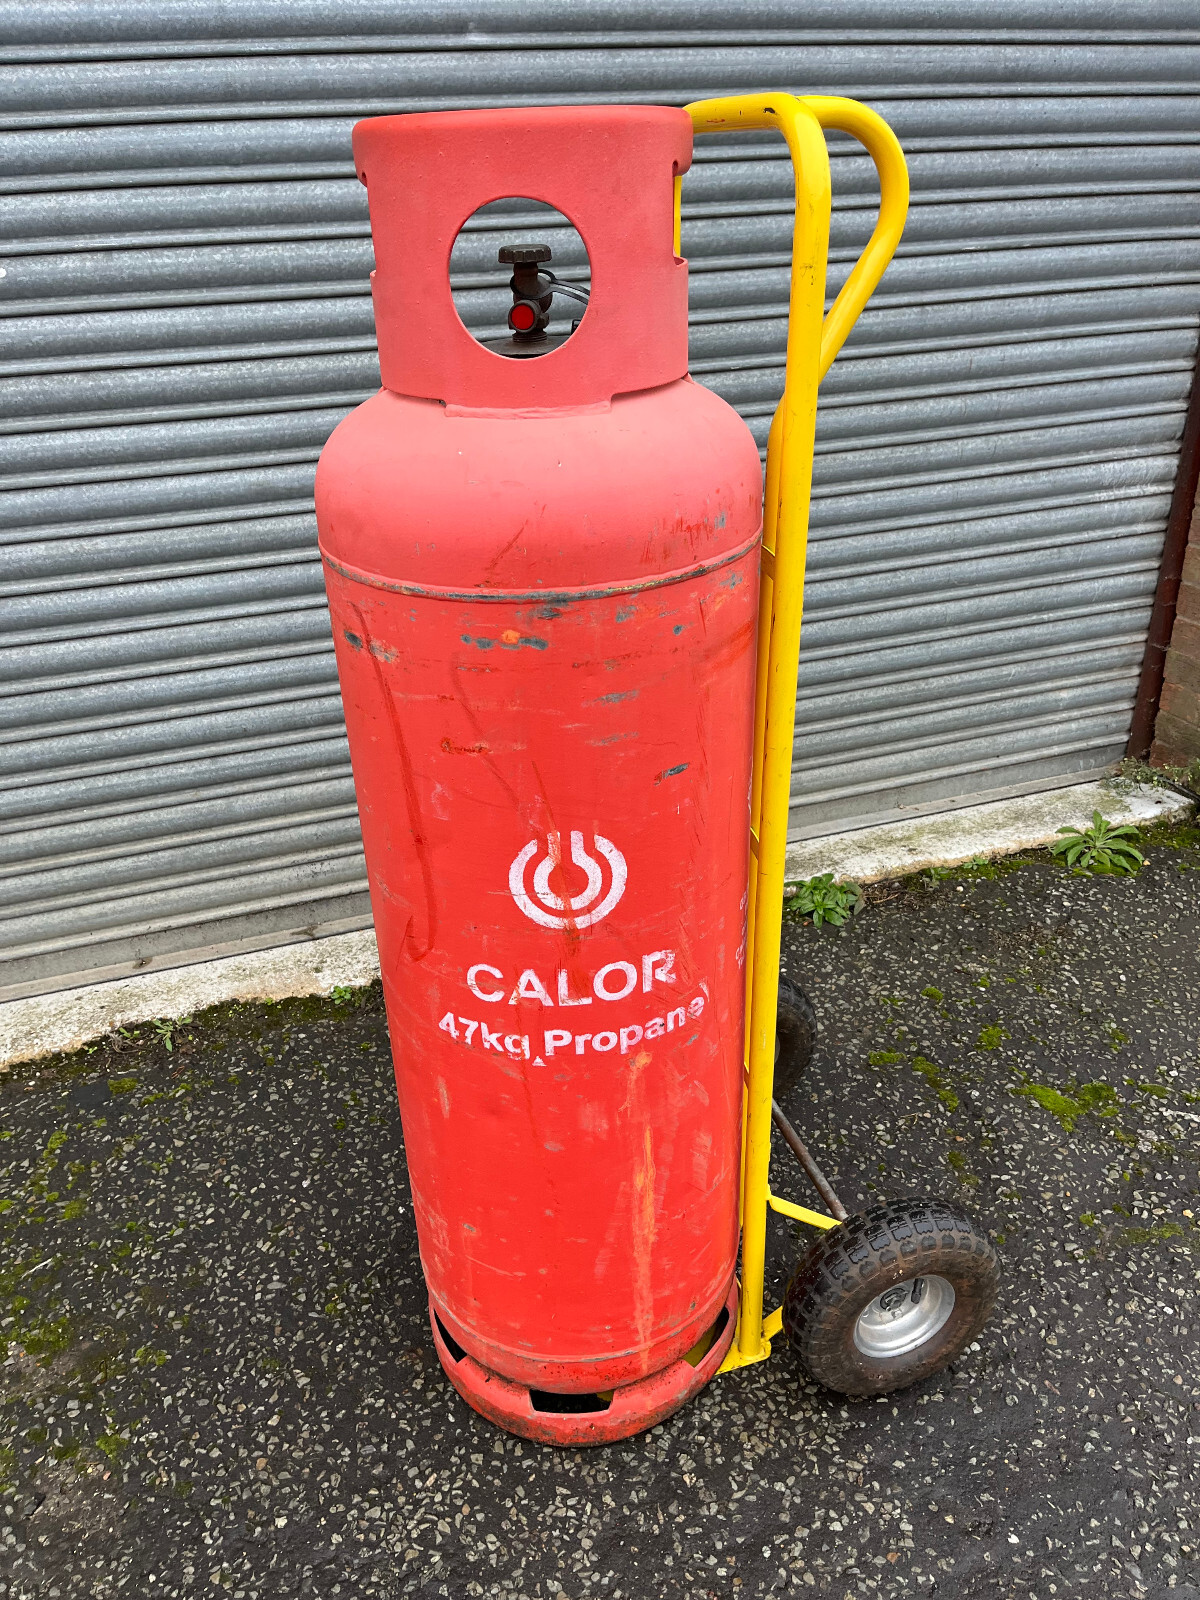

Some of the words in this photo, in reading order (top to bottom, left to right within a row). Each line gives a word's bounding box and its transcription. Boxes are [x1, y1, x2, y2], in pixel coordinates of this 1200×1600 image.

[466, 949, 677, 1007] CALOR
[438, 1012, 531, 1060] 47kg
[544, 996, 705, 1056] Propane
